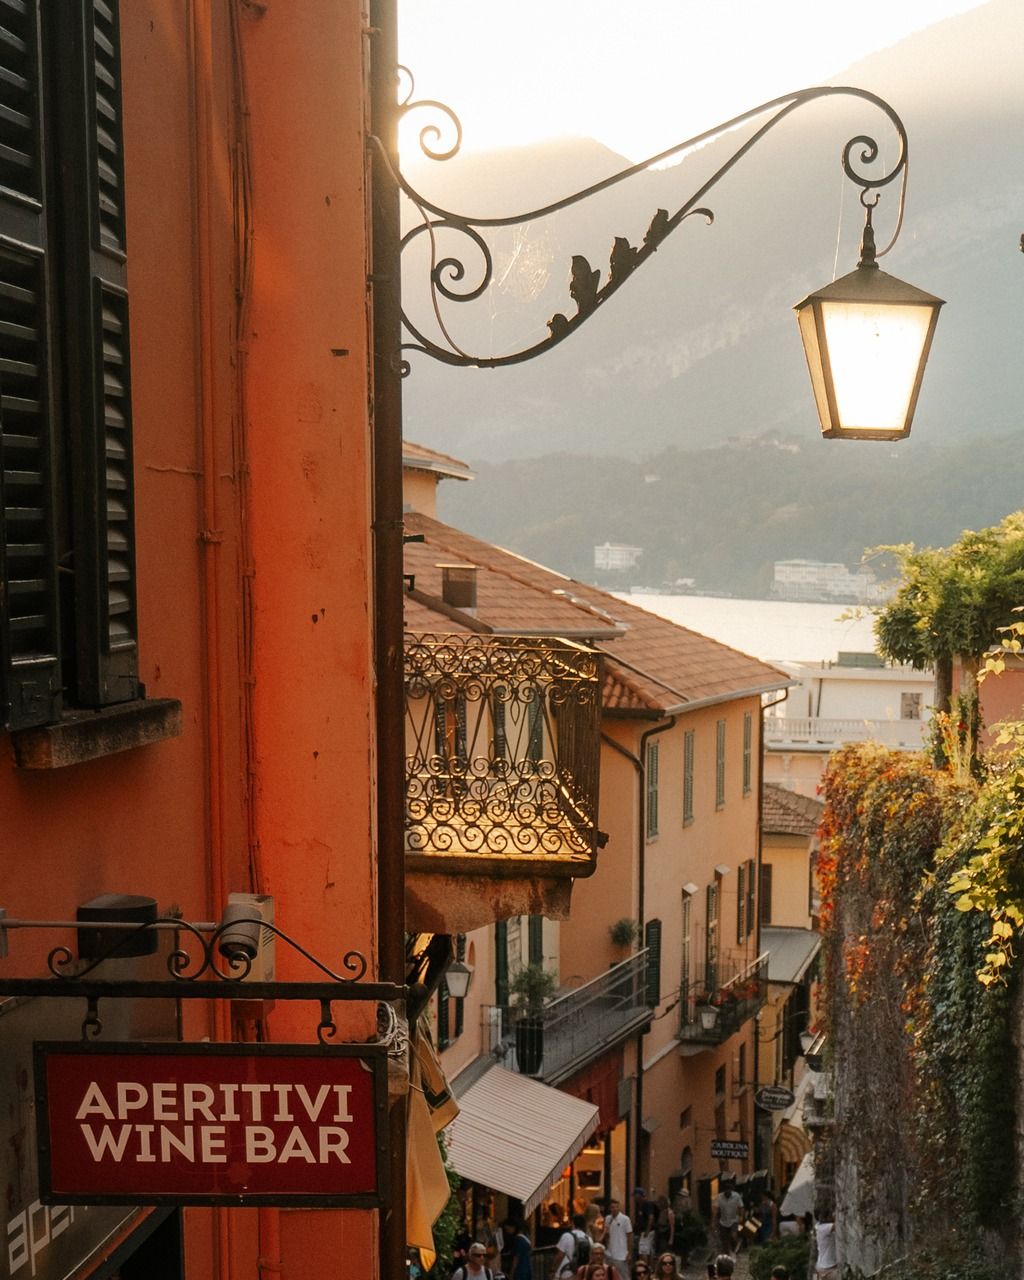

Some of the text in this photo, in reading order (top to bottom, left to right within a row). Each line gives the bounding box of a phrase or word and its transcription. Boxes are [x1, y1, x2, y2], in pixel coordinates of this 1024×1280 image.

[75, 1081, 353, 1123] APERITIVI
[81, 1123, 352, 1164] WINE BAR
[712, 1142, 748, 1151] CAROLINA
[712, 1150, 748, 1158] BOUTIQUE
